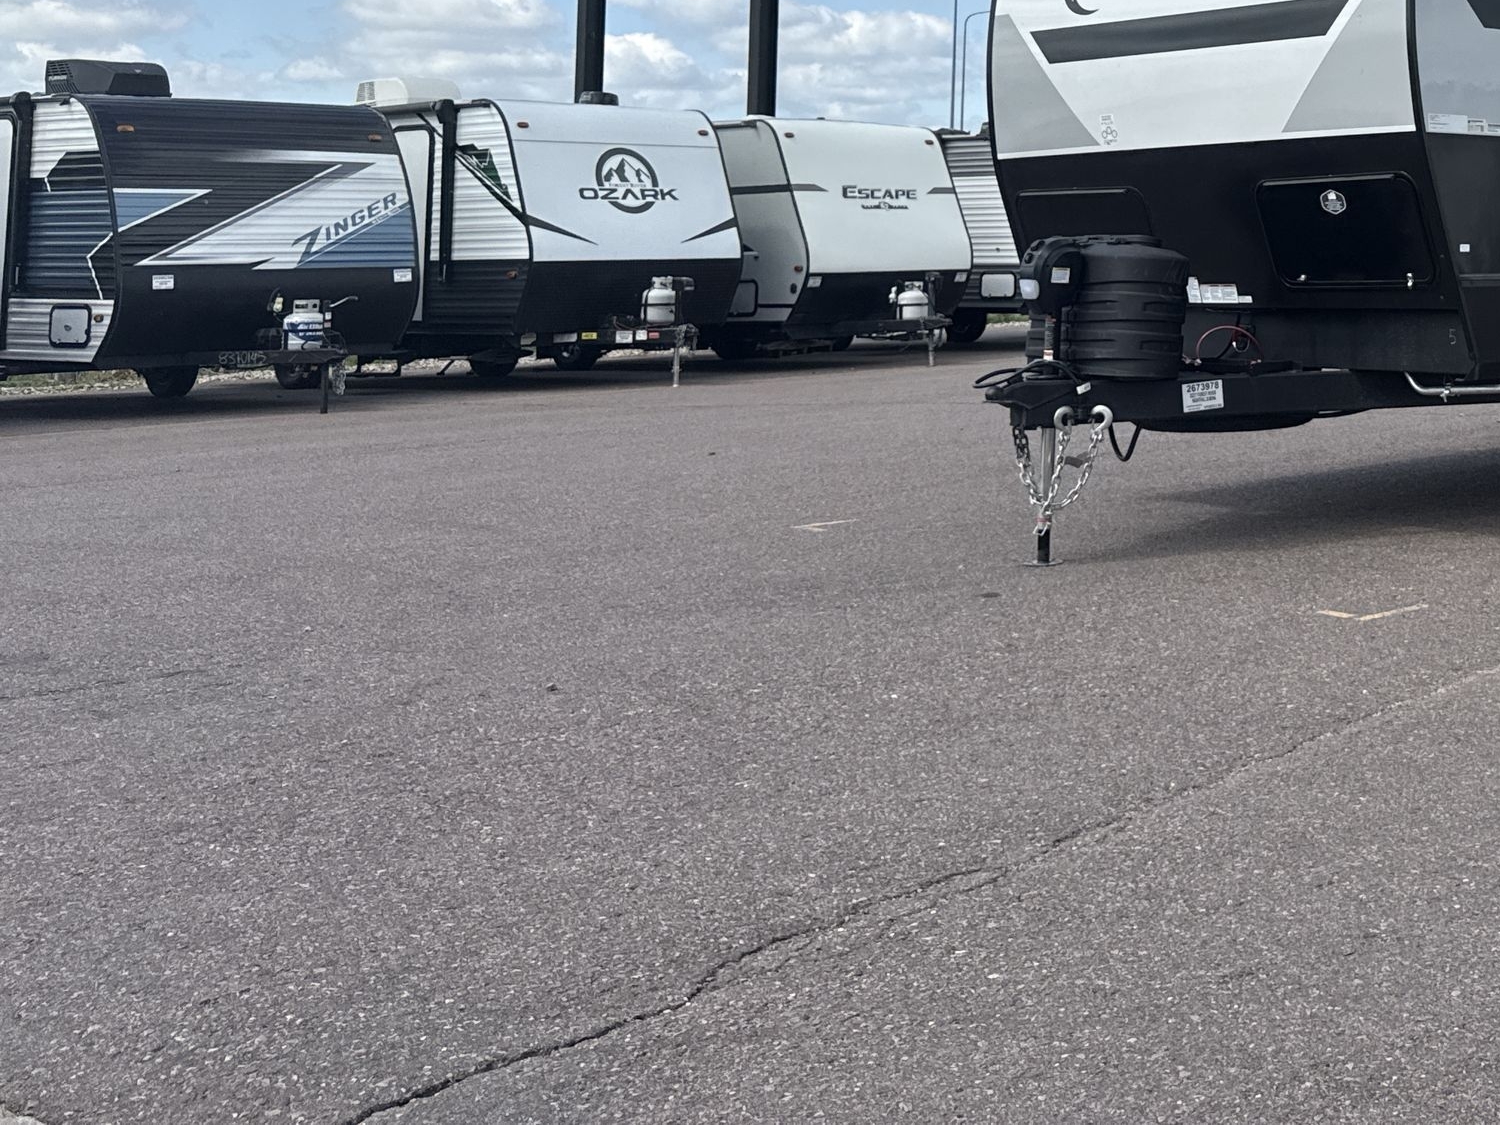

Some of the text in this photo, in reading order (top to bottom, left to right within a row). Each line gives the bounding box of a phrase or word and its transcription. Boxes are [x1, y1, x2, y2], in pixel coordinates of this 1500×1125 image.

[578, 187, 680, 201] OZARK
[291, 191, 397, 265] ZINGER
[1185, 380, 1220, 393] 2673978
